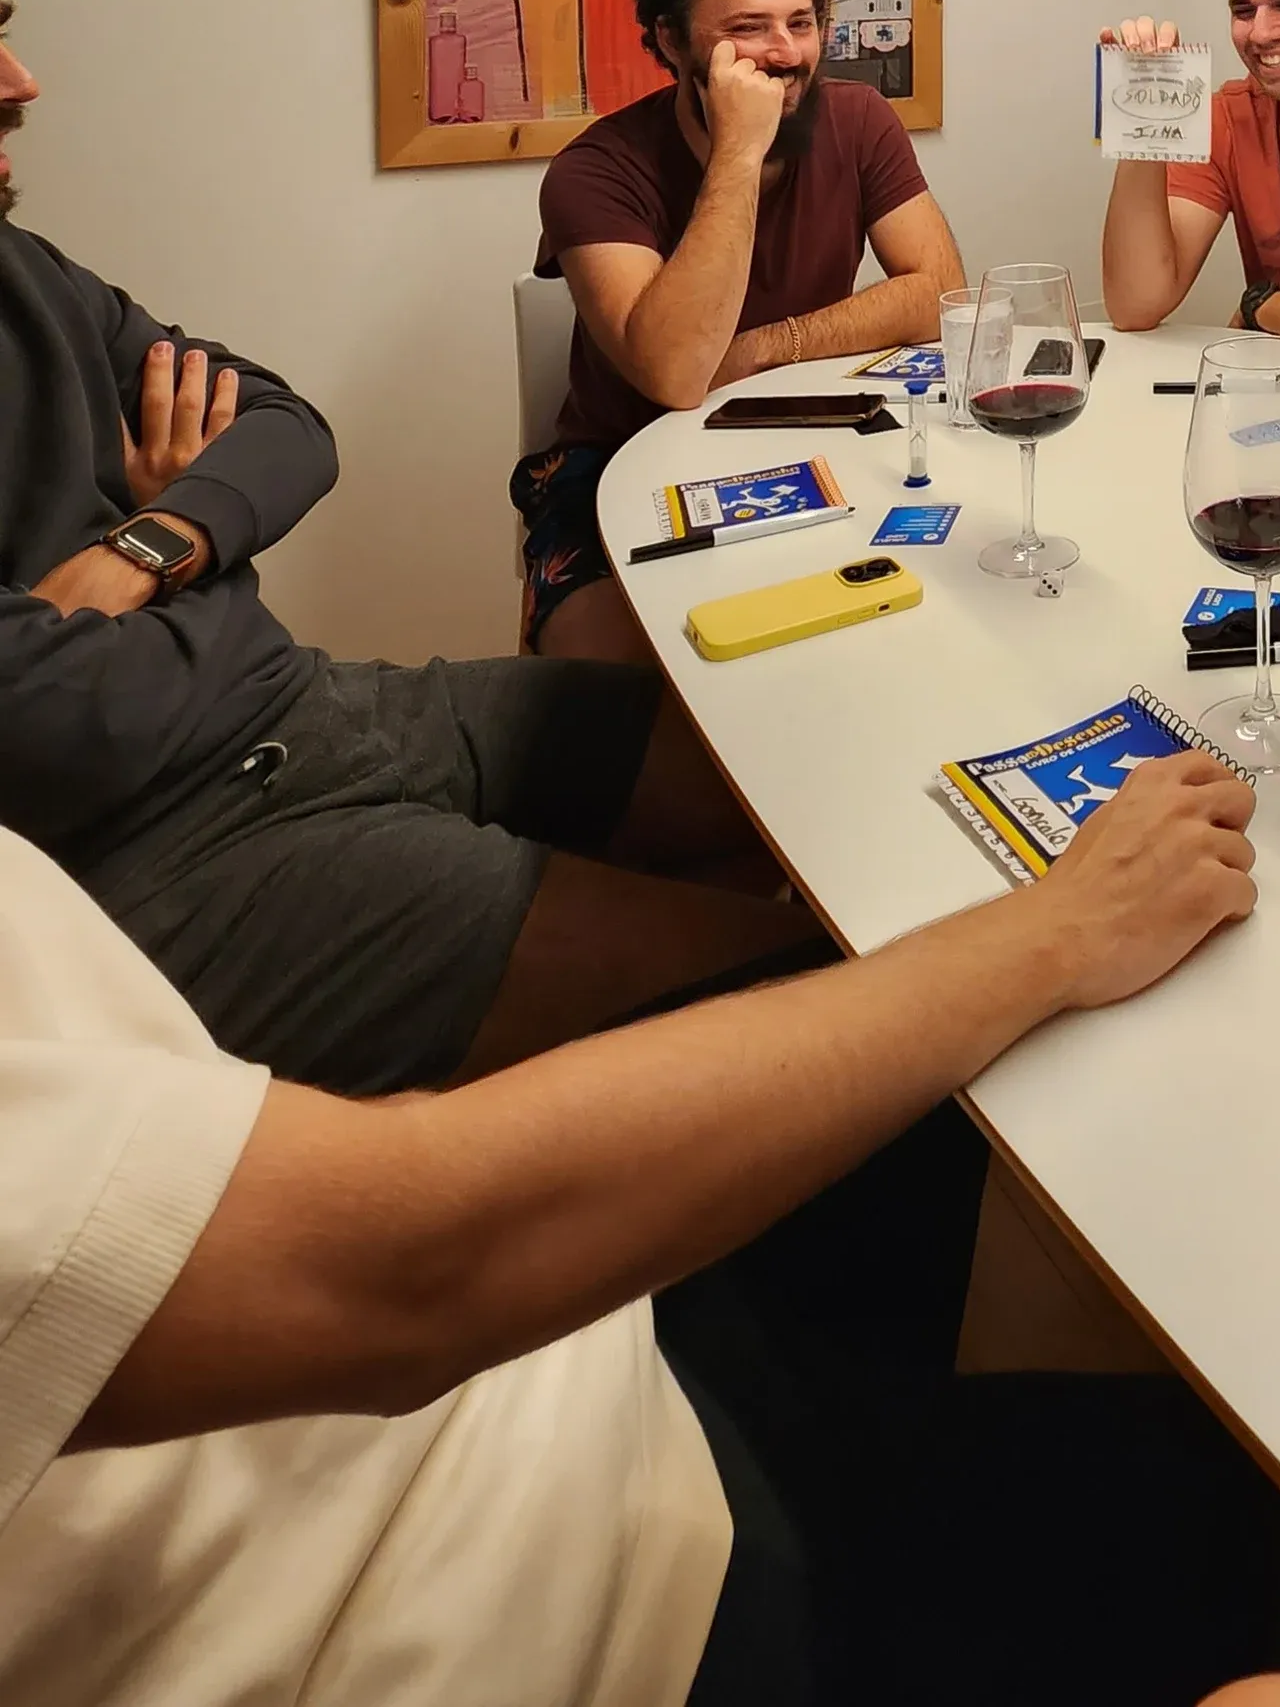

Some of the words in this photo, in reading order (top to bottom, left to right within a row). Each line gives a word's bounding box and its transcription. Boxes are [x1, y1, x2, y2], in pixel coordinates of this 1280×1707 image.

[1122, 89, 1200, 108] SOLDADO
[1026, 755, 1058, 770] LIVRO
[1059, 749, 1075, 758] DE
[1077, 722, 1132, 752] DESENHOS
[1010, 797, 1072, 850] Gonçalo
